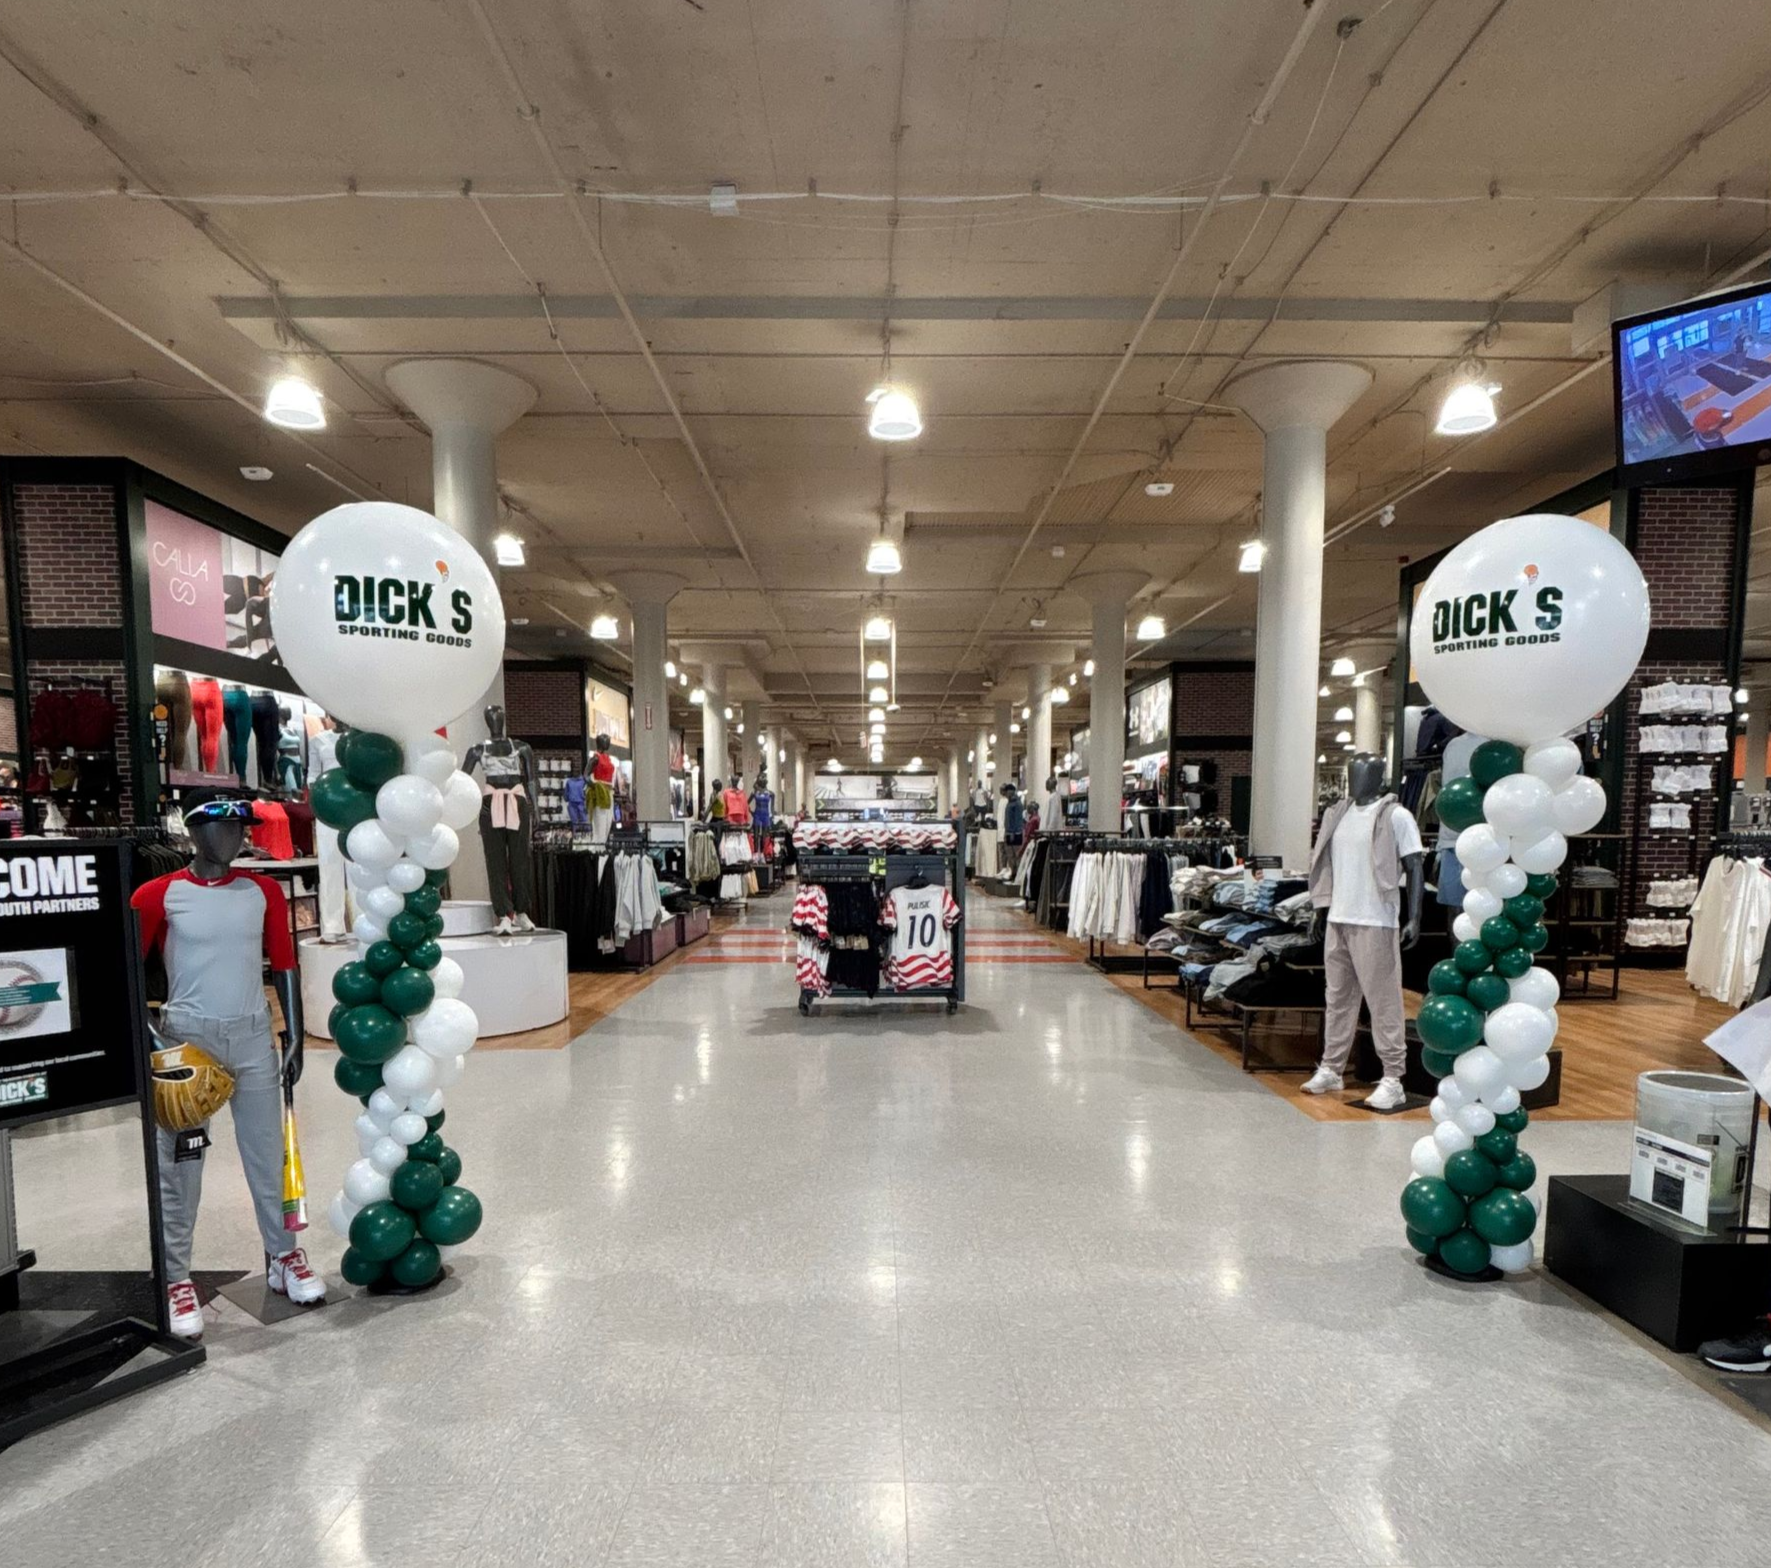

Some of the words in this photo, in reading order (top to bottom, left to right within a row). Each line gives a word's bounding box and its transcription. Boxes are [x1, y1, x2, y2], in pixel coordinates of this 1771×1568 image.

[335, 560, 472, 635] DICK'S
[1433, 564, 1563, 643] DICK'S
[338, 624, 420, 641] SPORTING
[426, 632, 472, 649] GOODS
[1433, 638, 1499, 655] SPORTING
[1505, 632, 1561, 646] GOODS
[33, 897, 100, 914] PARTNERS
[908, 913, 936, 949] 10
[0, 1076, 46, 1101] ICK'S
